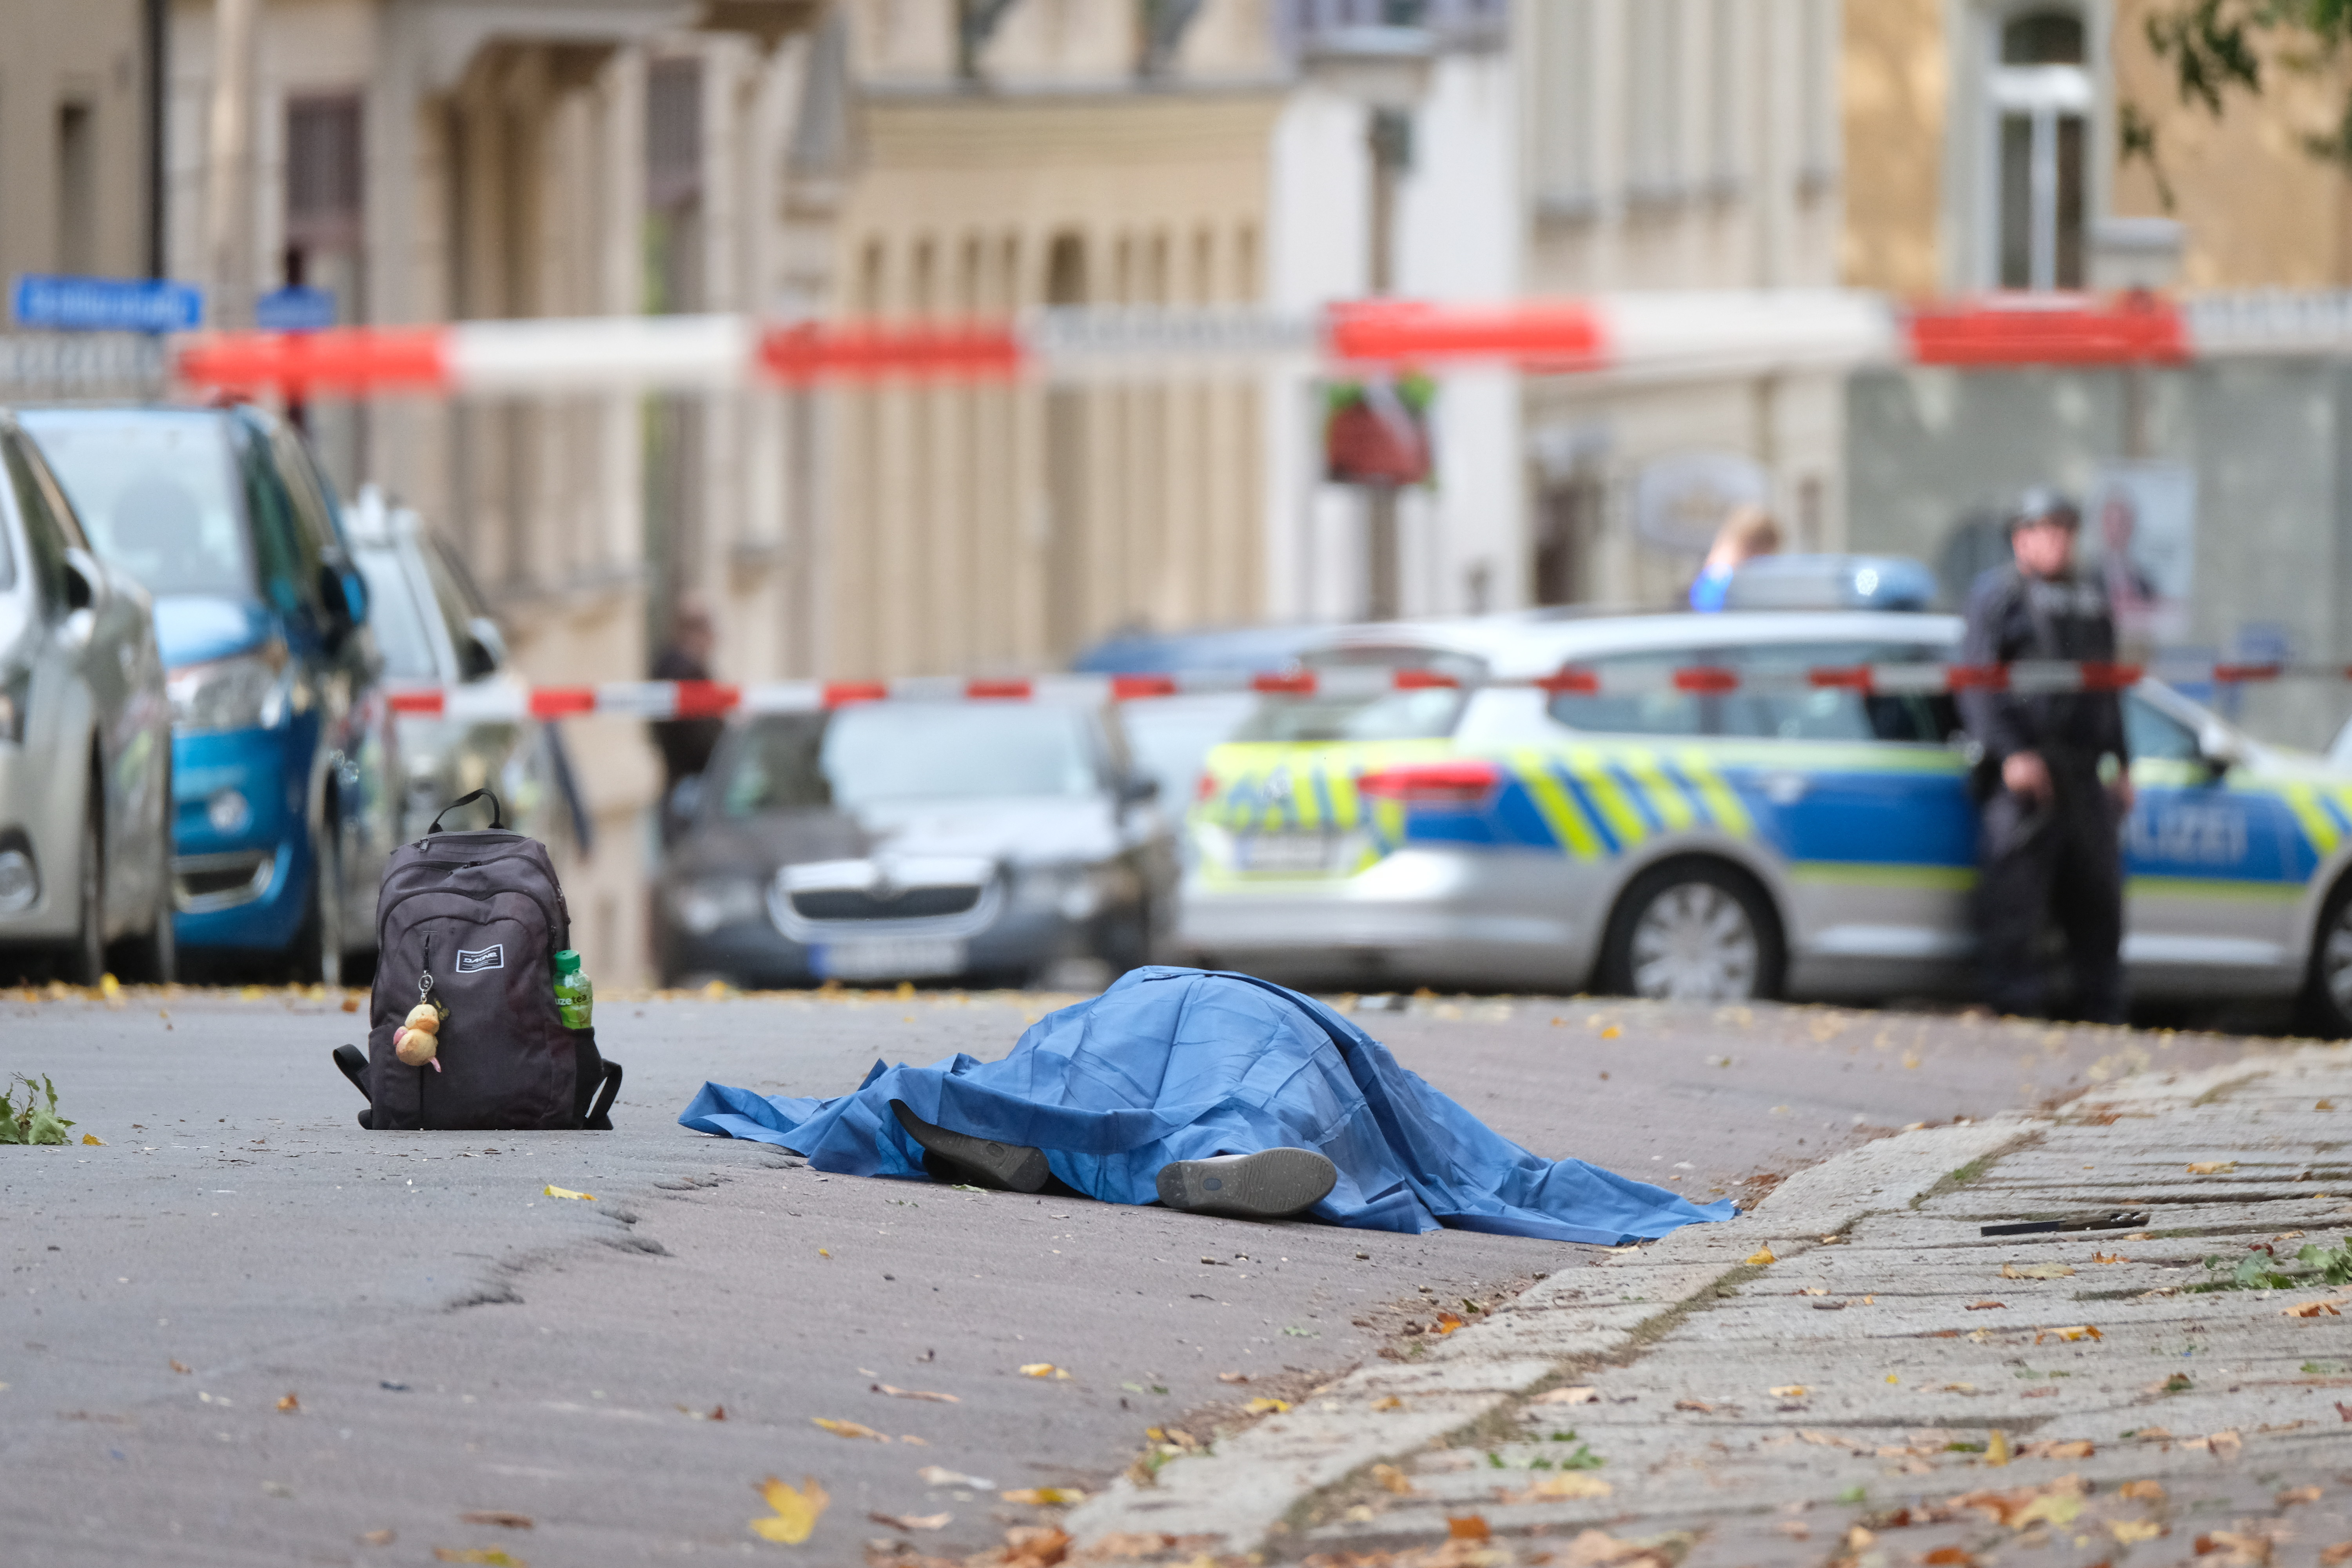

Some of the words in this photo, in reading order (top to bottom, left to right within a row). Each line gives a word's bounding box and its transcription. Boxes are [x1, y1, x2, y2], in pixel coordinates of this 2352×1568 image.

[2118, 800, 2247, 862] LIZEI
[463, 952, 498, 963] DAKINE
[554, 994, 587, 1005] uzetea
